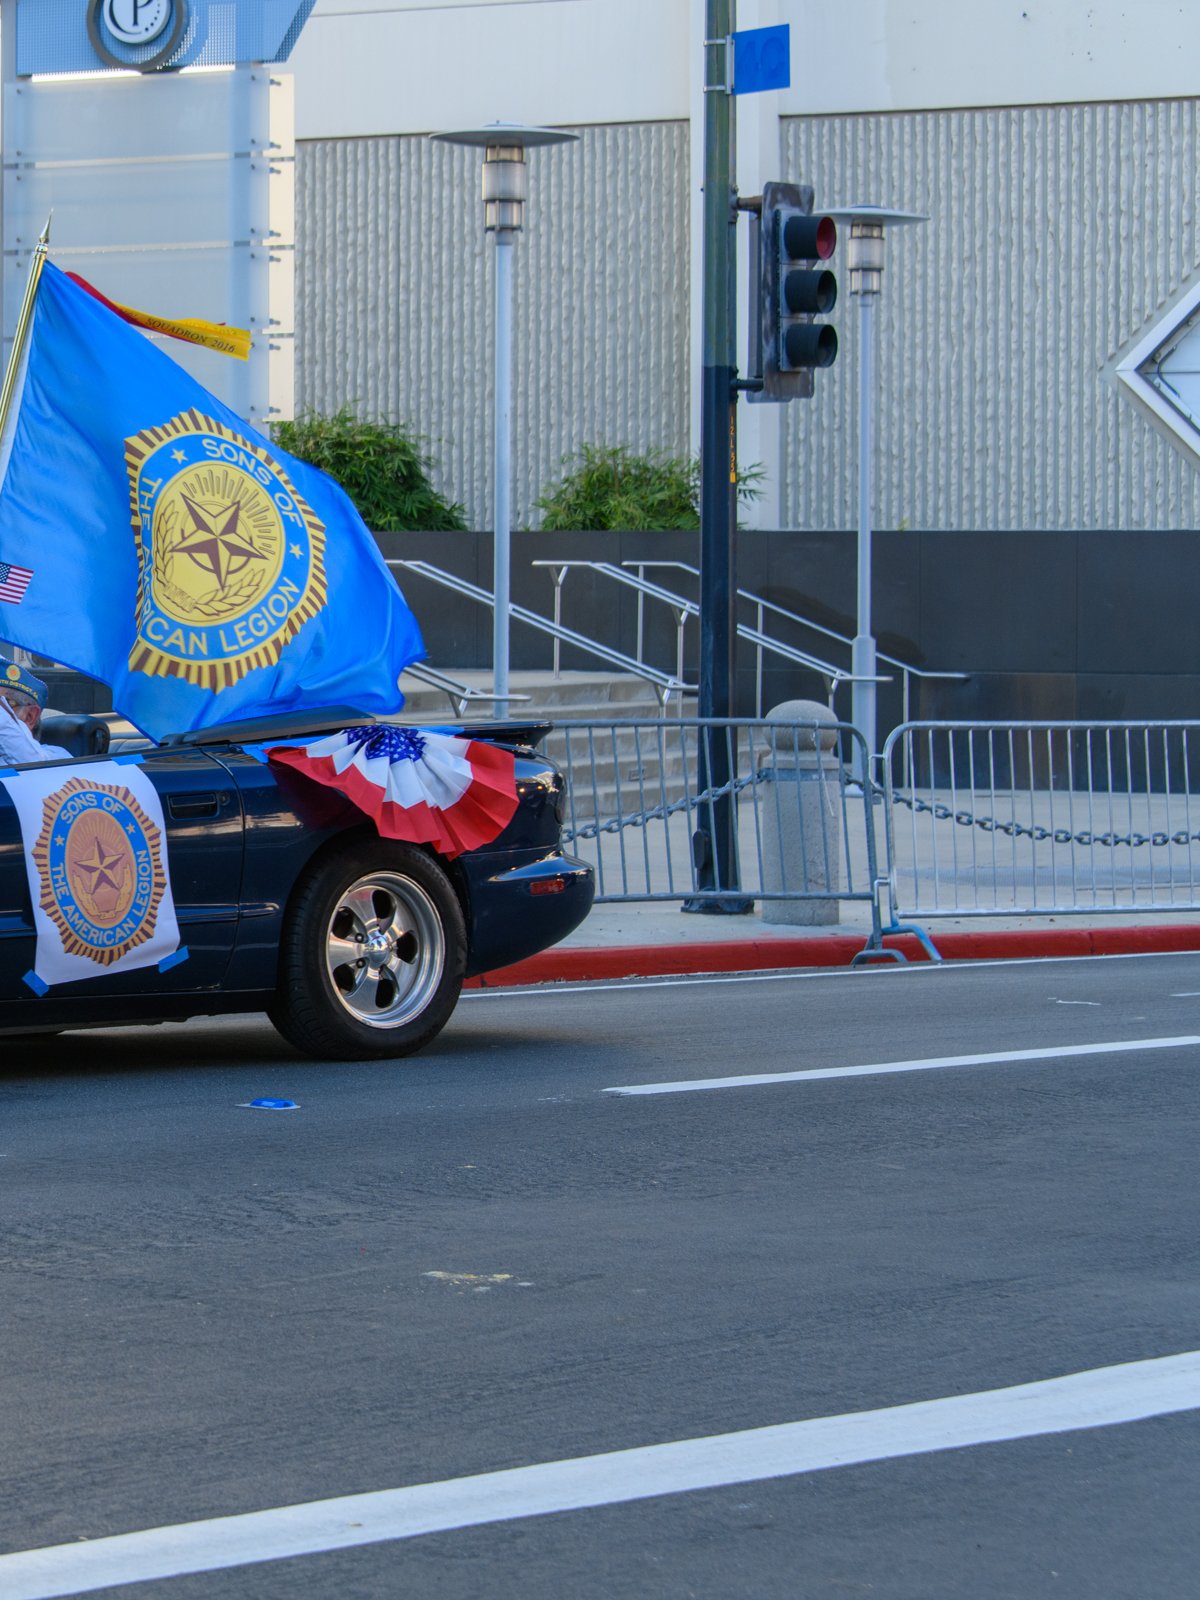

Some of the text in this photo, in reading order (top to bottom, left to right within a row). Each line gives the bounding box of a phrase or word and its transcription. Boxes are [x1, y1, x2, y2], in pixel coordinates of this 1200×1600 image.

[145, 318, 207, 343] SQUADRON
[211, 339, 236, 353] 2016
[201, 438, 302, 528] SONS OF
[139, 477, 163, 531] THE
[219, 577, 300, 653] LEGION
[61, 793, 125, 824] SONS OF
[52, 850, 151, 945] THE AMERICAN LEGION
